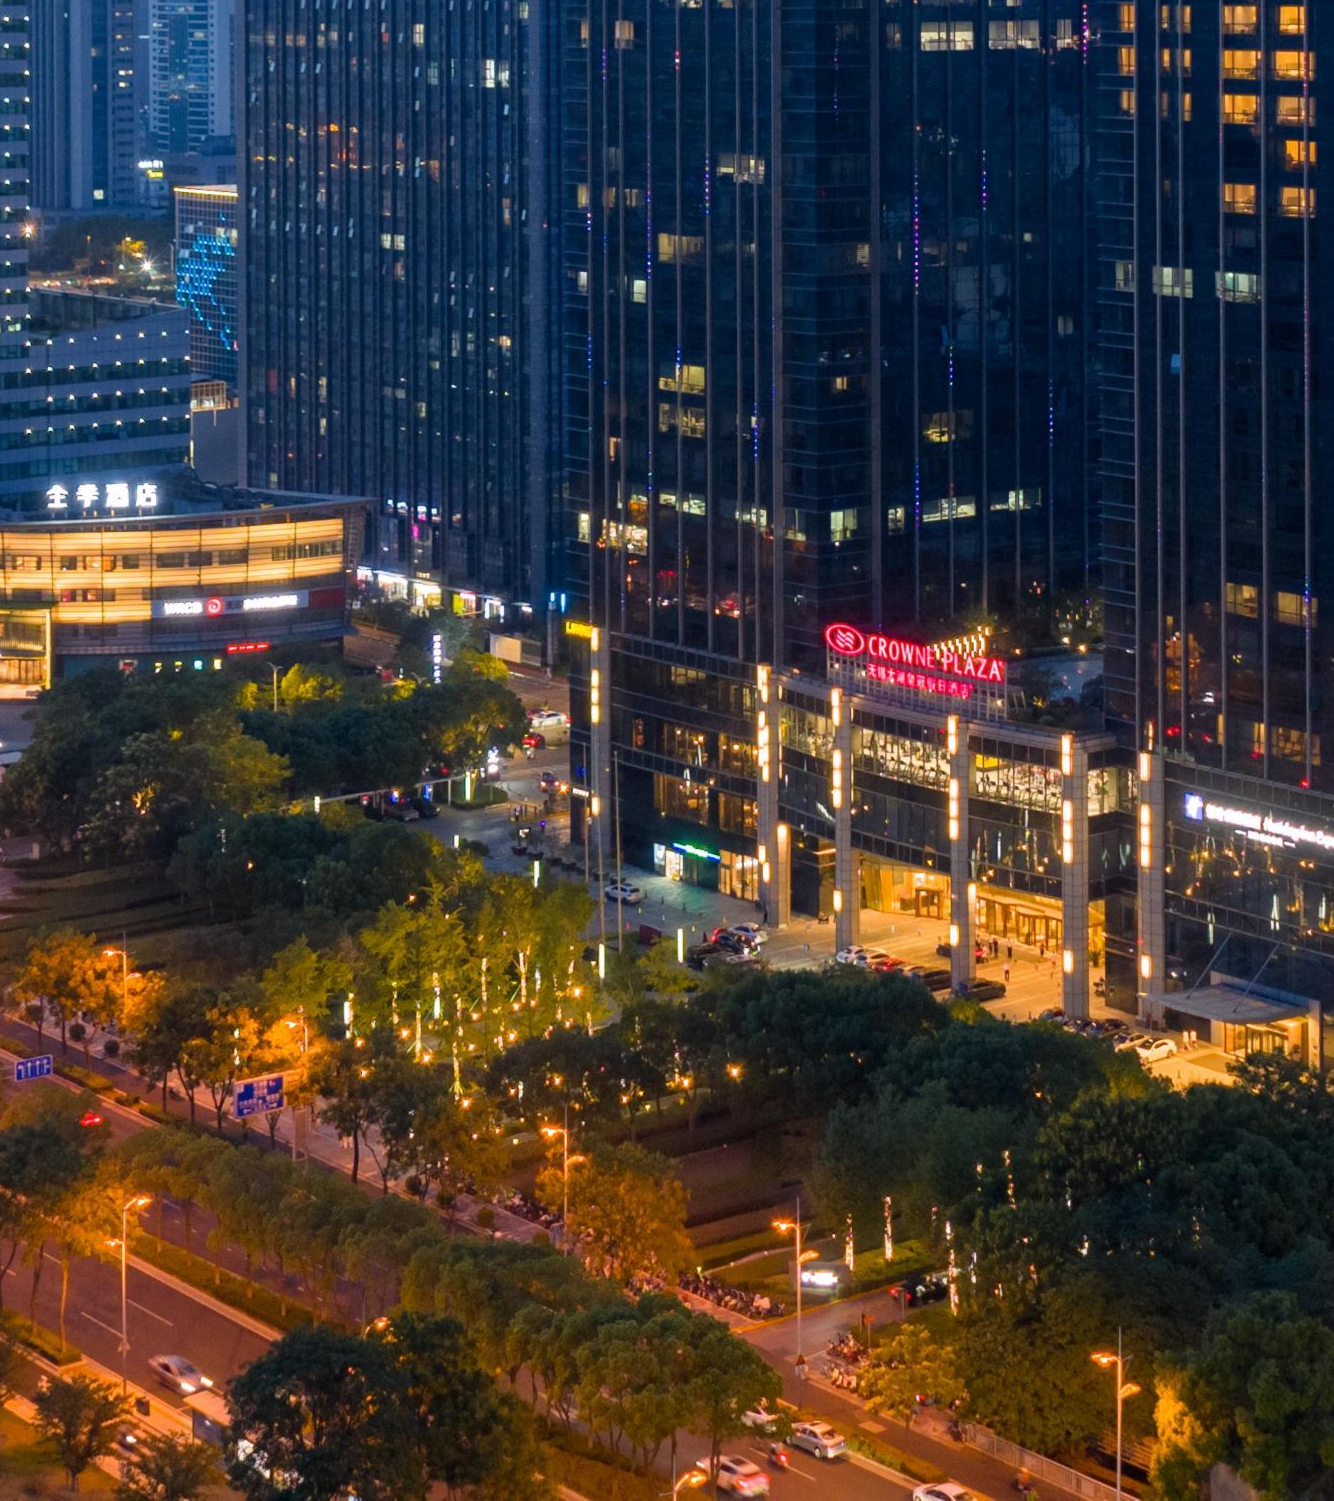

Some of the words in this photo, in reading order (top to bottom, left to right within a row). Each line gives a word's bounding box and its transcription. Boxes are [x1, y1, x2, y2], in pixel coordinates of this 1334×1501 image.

[46, 483, 158, 509] 全季酒店
[868, 636, 936, 669] CROWNE
[942, 650, 1004, 682] PLAZA
